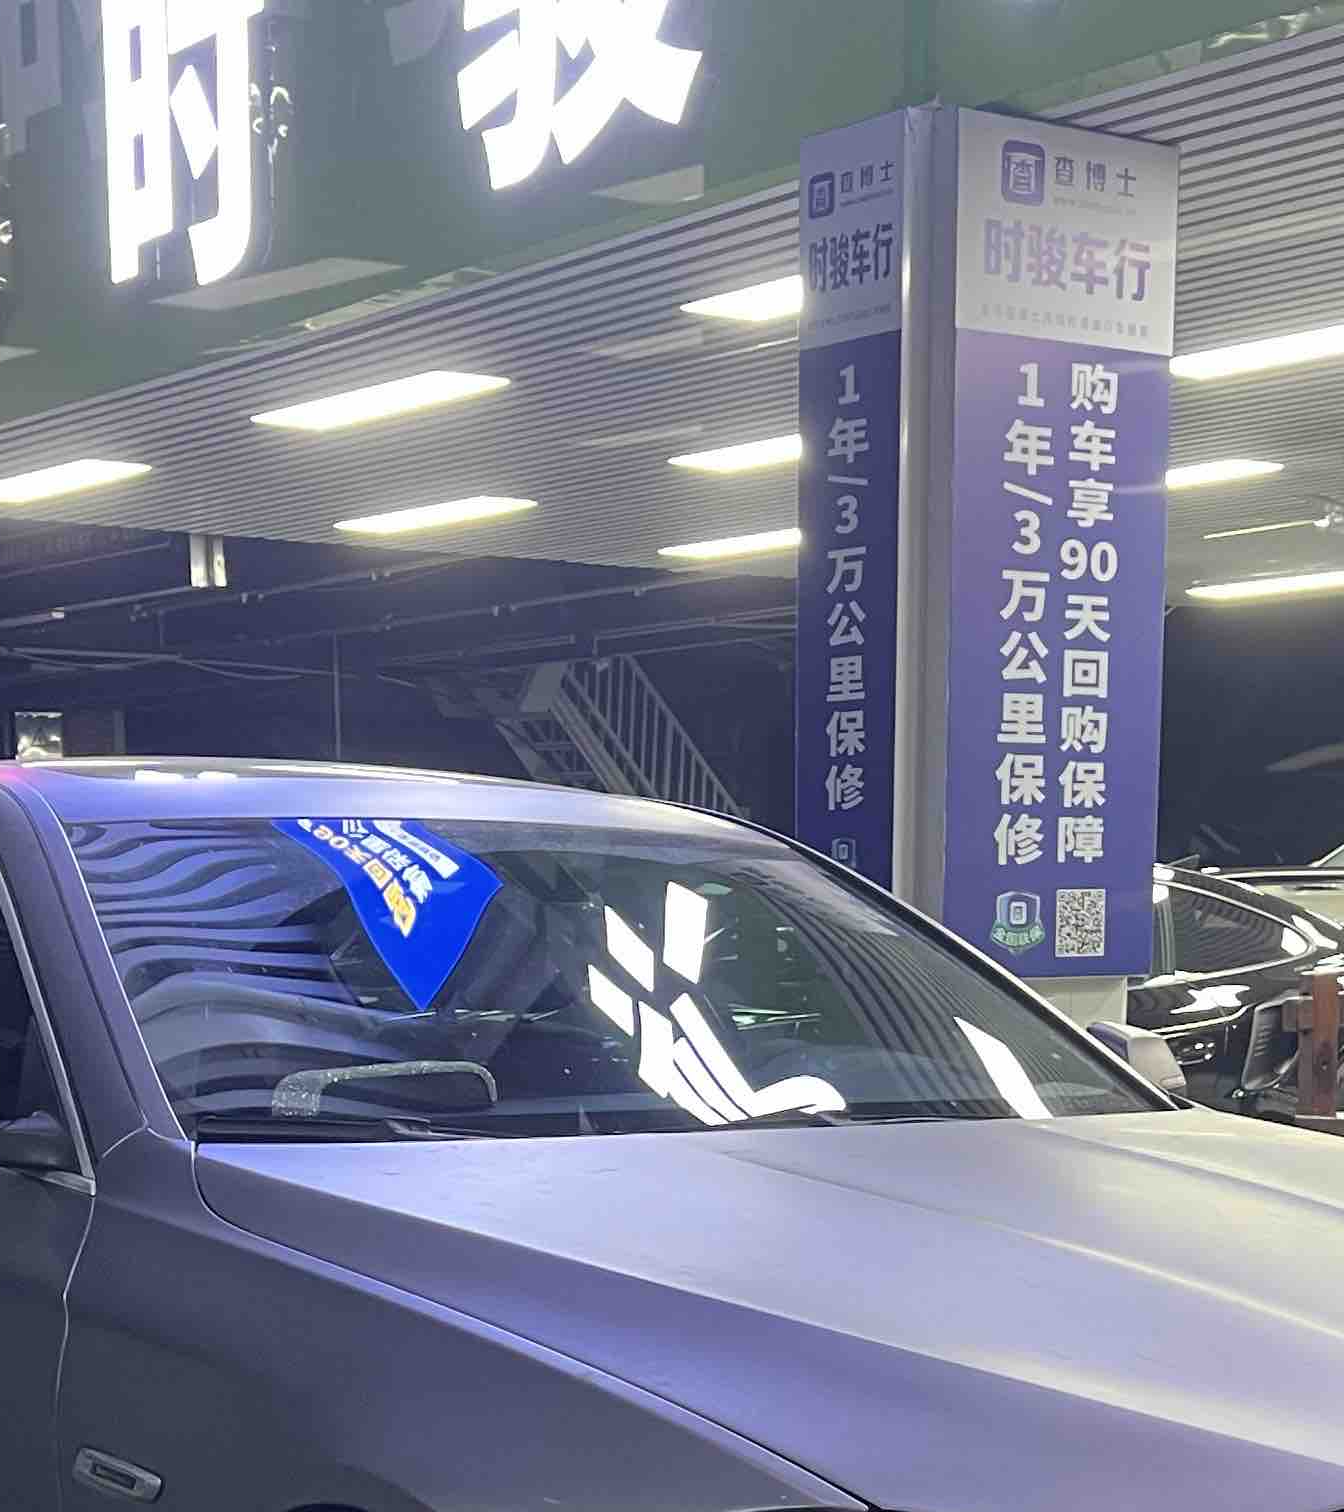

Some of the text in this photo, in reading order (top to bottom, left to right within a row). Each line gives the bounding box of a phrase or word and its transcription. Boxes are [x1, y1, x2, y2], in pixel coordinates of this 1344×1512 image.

[809, 222, 894, 294] 时骏车行
[984, 218, 1152, 303] 时骏车行
[993, 362, 1055, 866] 1年/3万公里保修
[1056, 362, 1120, 864] 购车享90天回购保障
